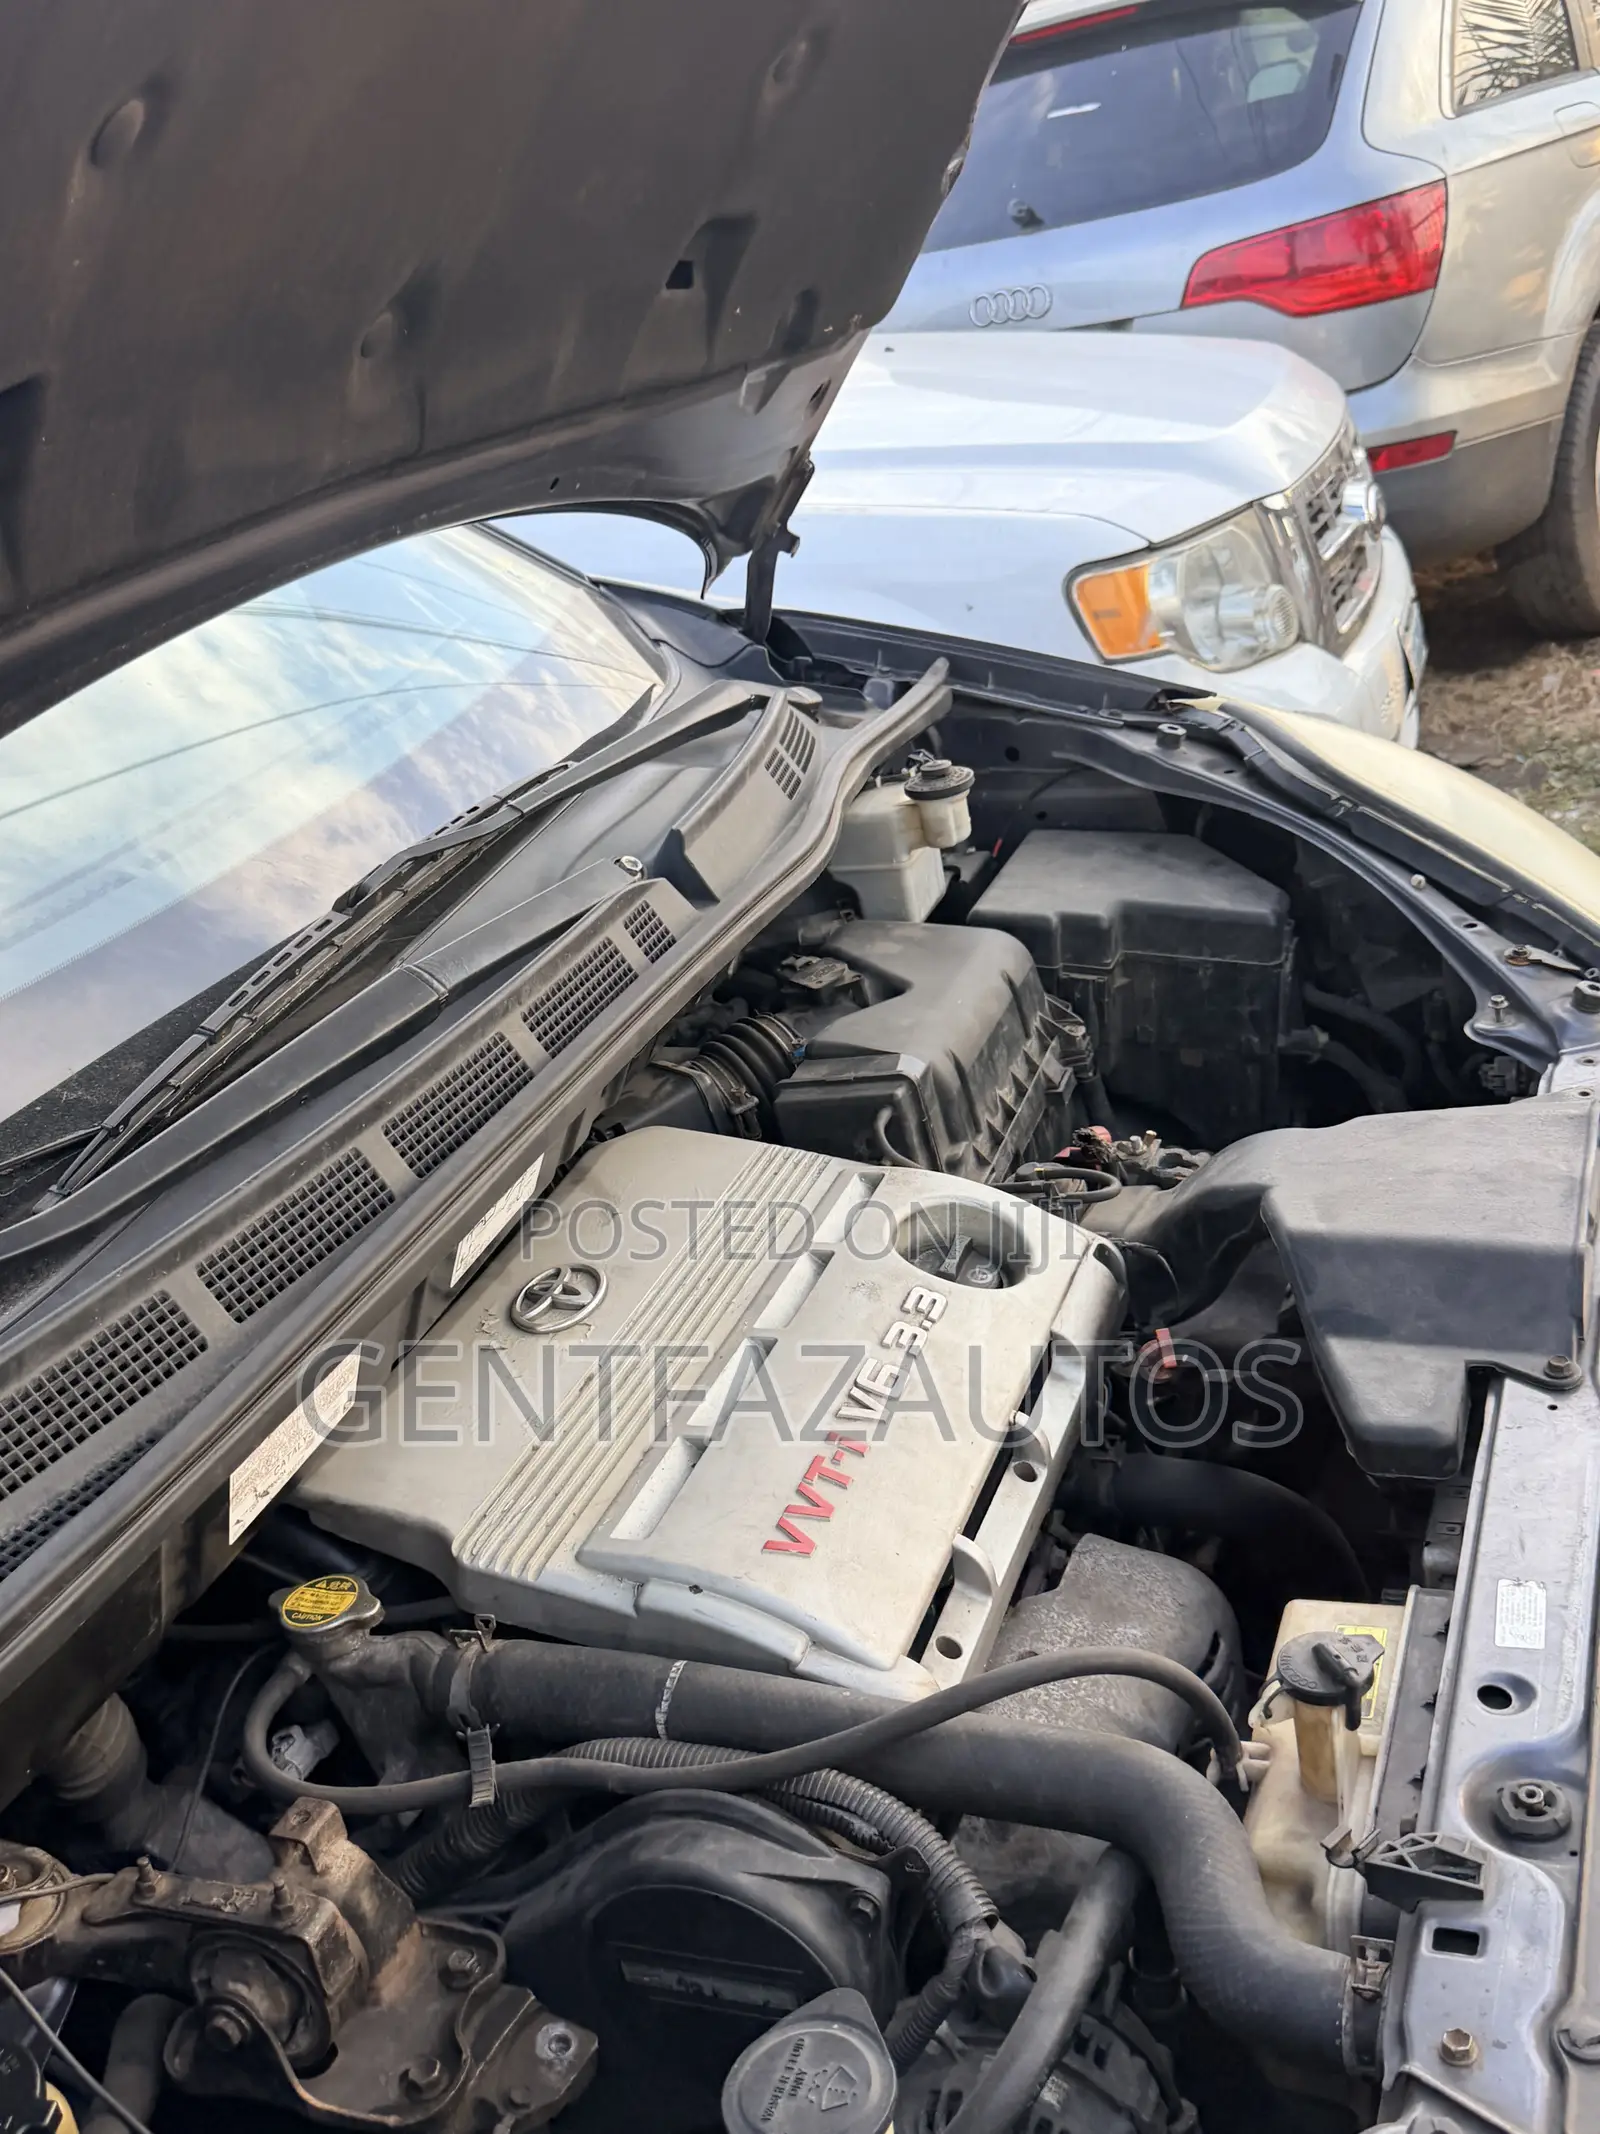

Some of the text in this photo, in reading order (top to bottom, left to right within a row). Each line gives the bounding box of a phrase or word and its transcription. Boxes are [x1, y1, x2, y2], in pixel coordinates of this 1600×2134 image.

[836, 1357, 911, 1424] V6
[881, 1286, 948, 1358] 3.3
[291, 1611, 324, 1621] CAUTION
